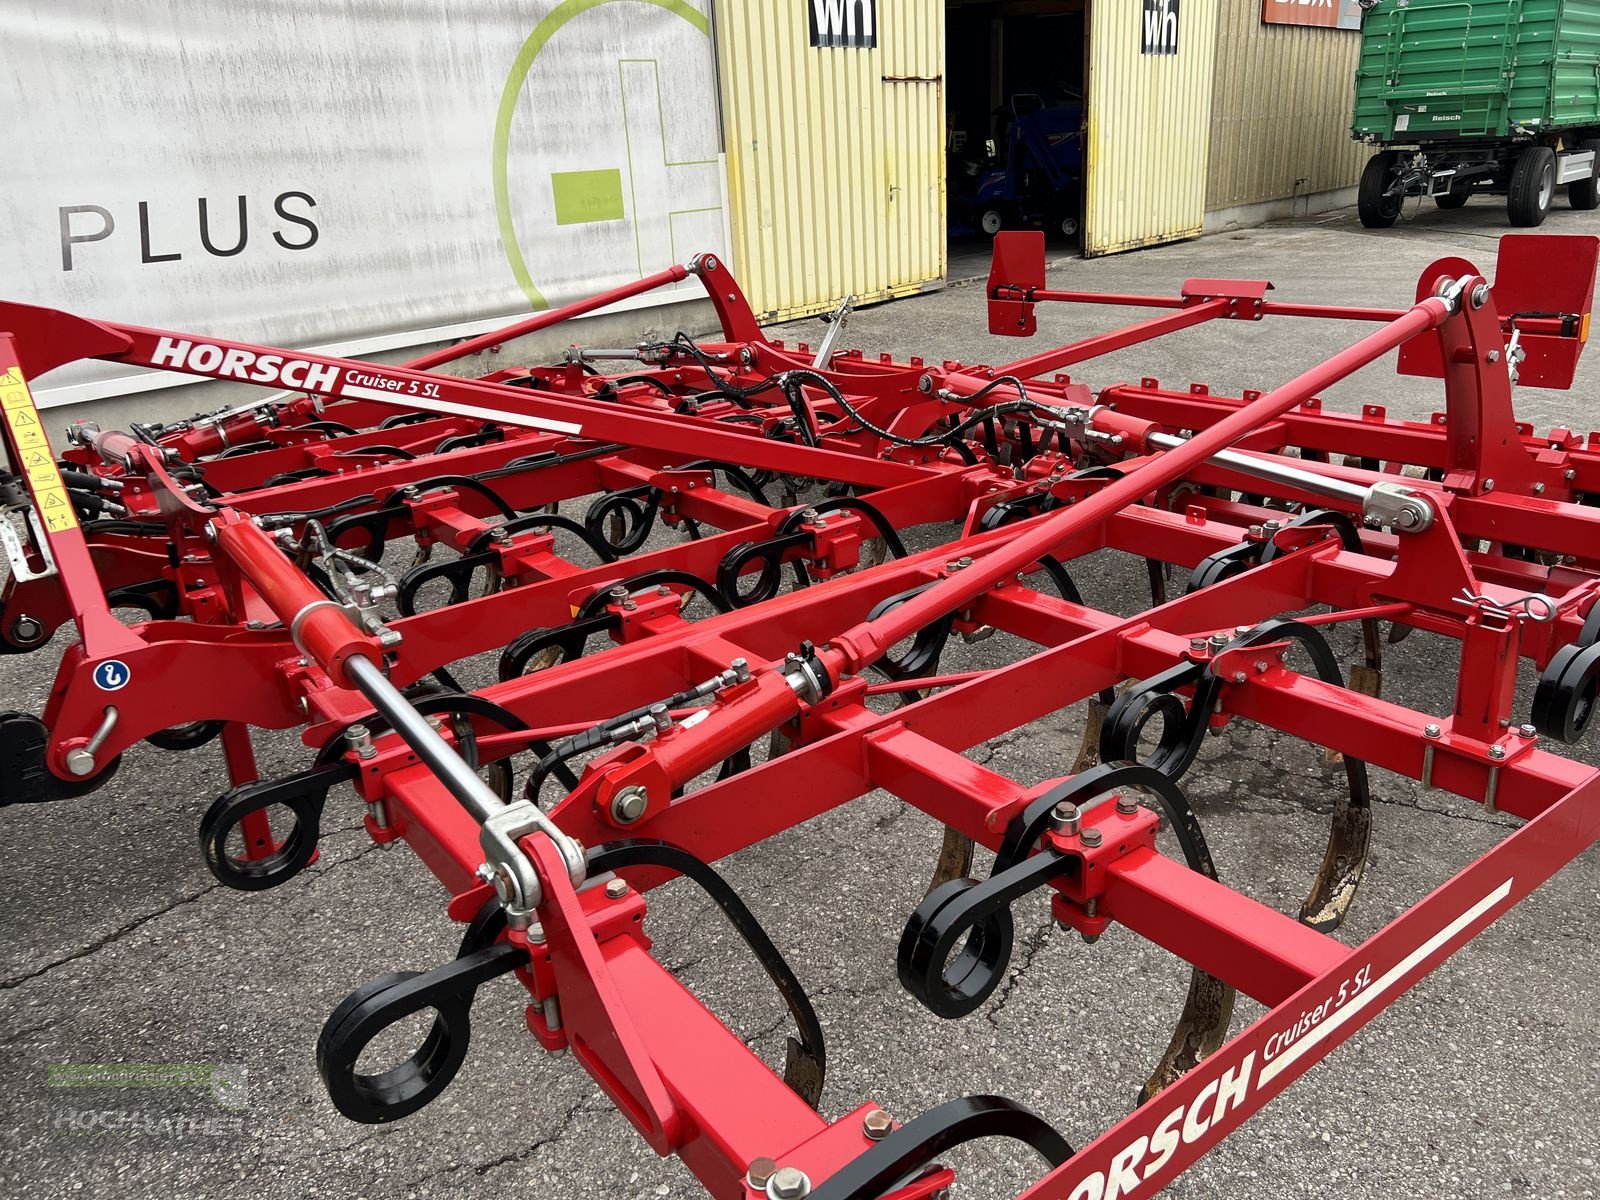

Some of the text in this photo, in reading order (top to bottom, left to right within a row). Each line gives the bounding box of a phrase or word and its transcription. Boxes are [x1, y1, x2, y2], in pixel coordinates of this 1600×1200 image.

[1432, 114, 1461, 122] Reisch
[59, 191, 319, 271] PLUS
[151, 336, 441, 398] HORSCH Cruiser 5 SL
[1058, 963, 1371, 1200] RSCH Cruiser 5 SL
